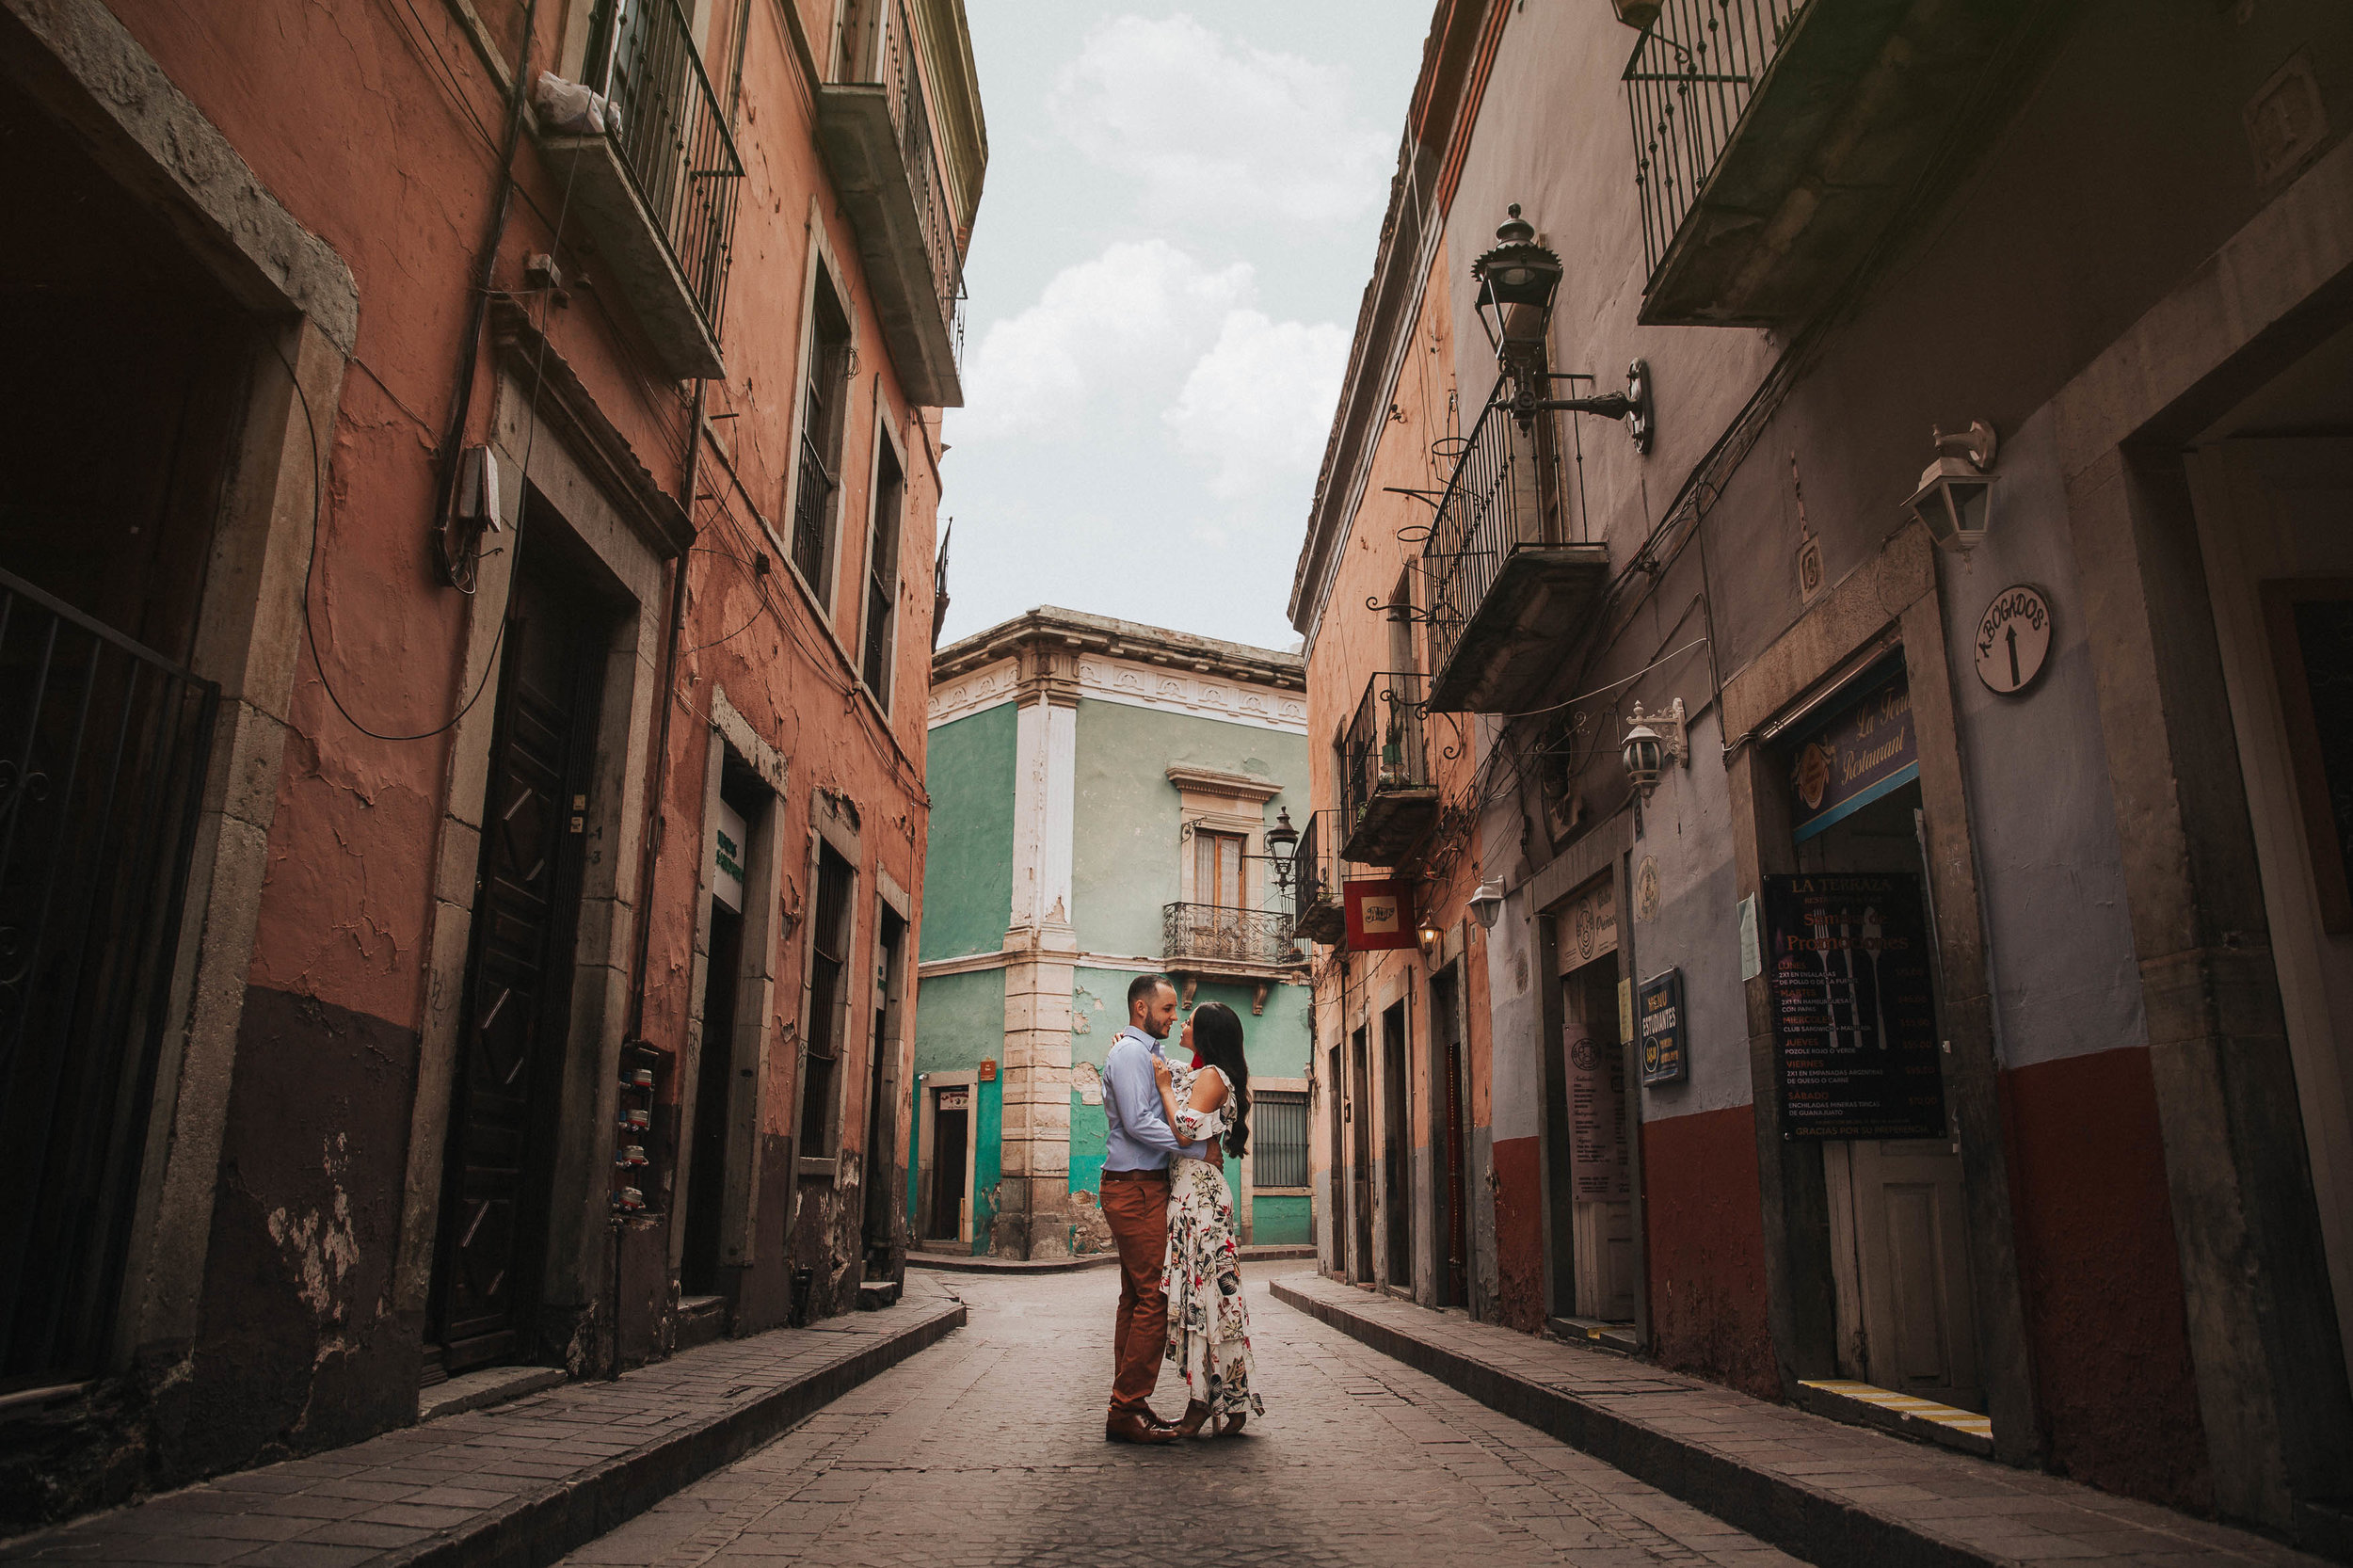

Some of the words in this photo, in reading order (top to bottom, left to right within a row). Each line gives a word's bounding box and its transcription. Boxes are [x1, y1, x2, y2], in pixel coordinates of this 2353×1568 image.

[1978, 593, 2043, 657] ABOGADOS
[1856, 705, 1874, 741] La
[1841, 727, 1905, 786] Restaurant
[1792, 878, 1815, 893] LA
[1818, 878, 1892, 892] TERRAZA
[1786, 934, 1910, 952] Promociones
[1778, 962, 1807, 970] LUNES
[1648, 988, 1668, 1013] MENU
[1780, 988, 1817, 998] MARTES
[1641, 1006, 1676, 1037] ESTUDIANTES
[1785, 1038, 1819, 1047] JUEVES
[1785, 1060, 1824, 1069] VIERNES
[1795, 1127, 1838, 1136] GRACIAS
[1839, 1127, 1859, 1135] POR
[1861, 1127, 1873, 1135] SU
